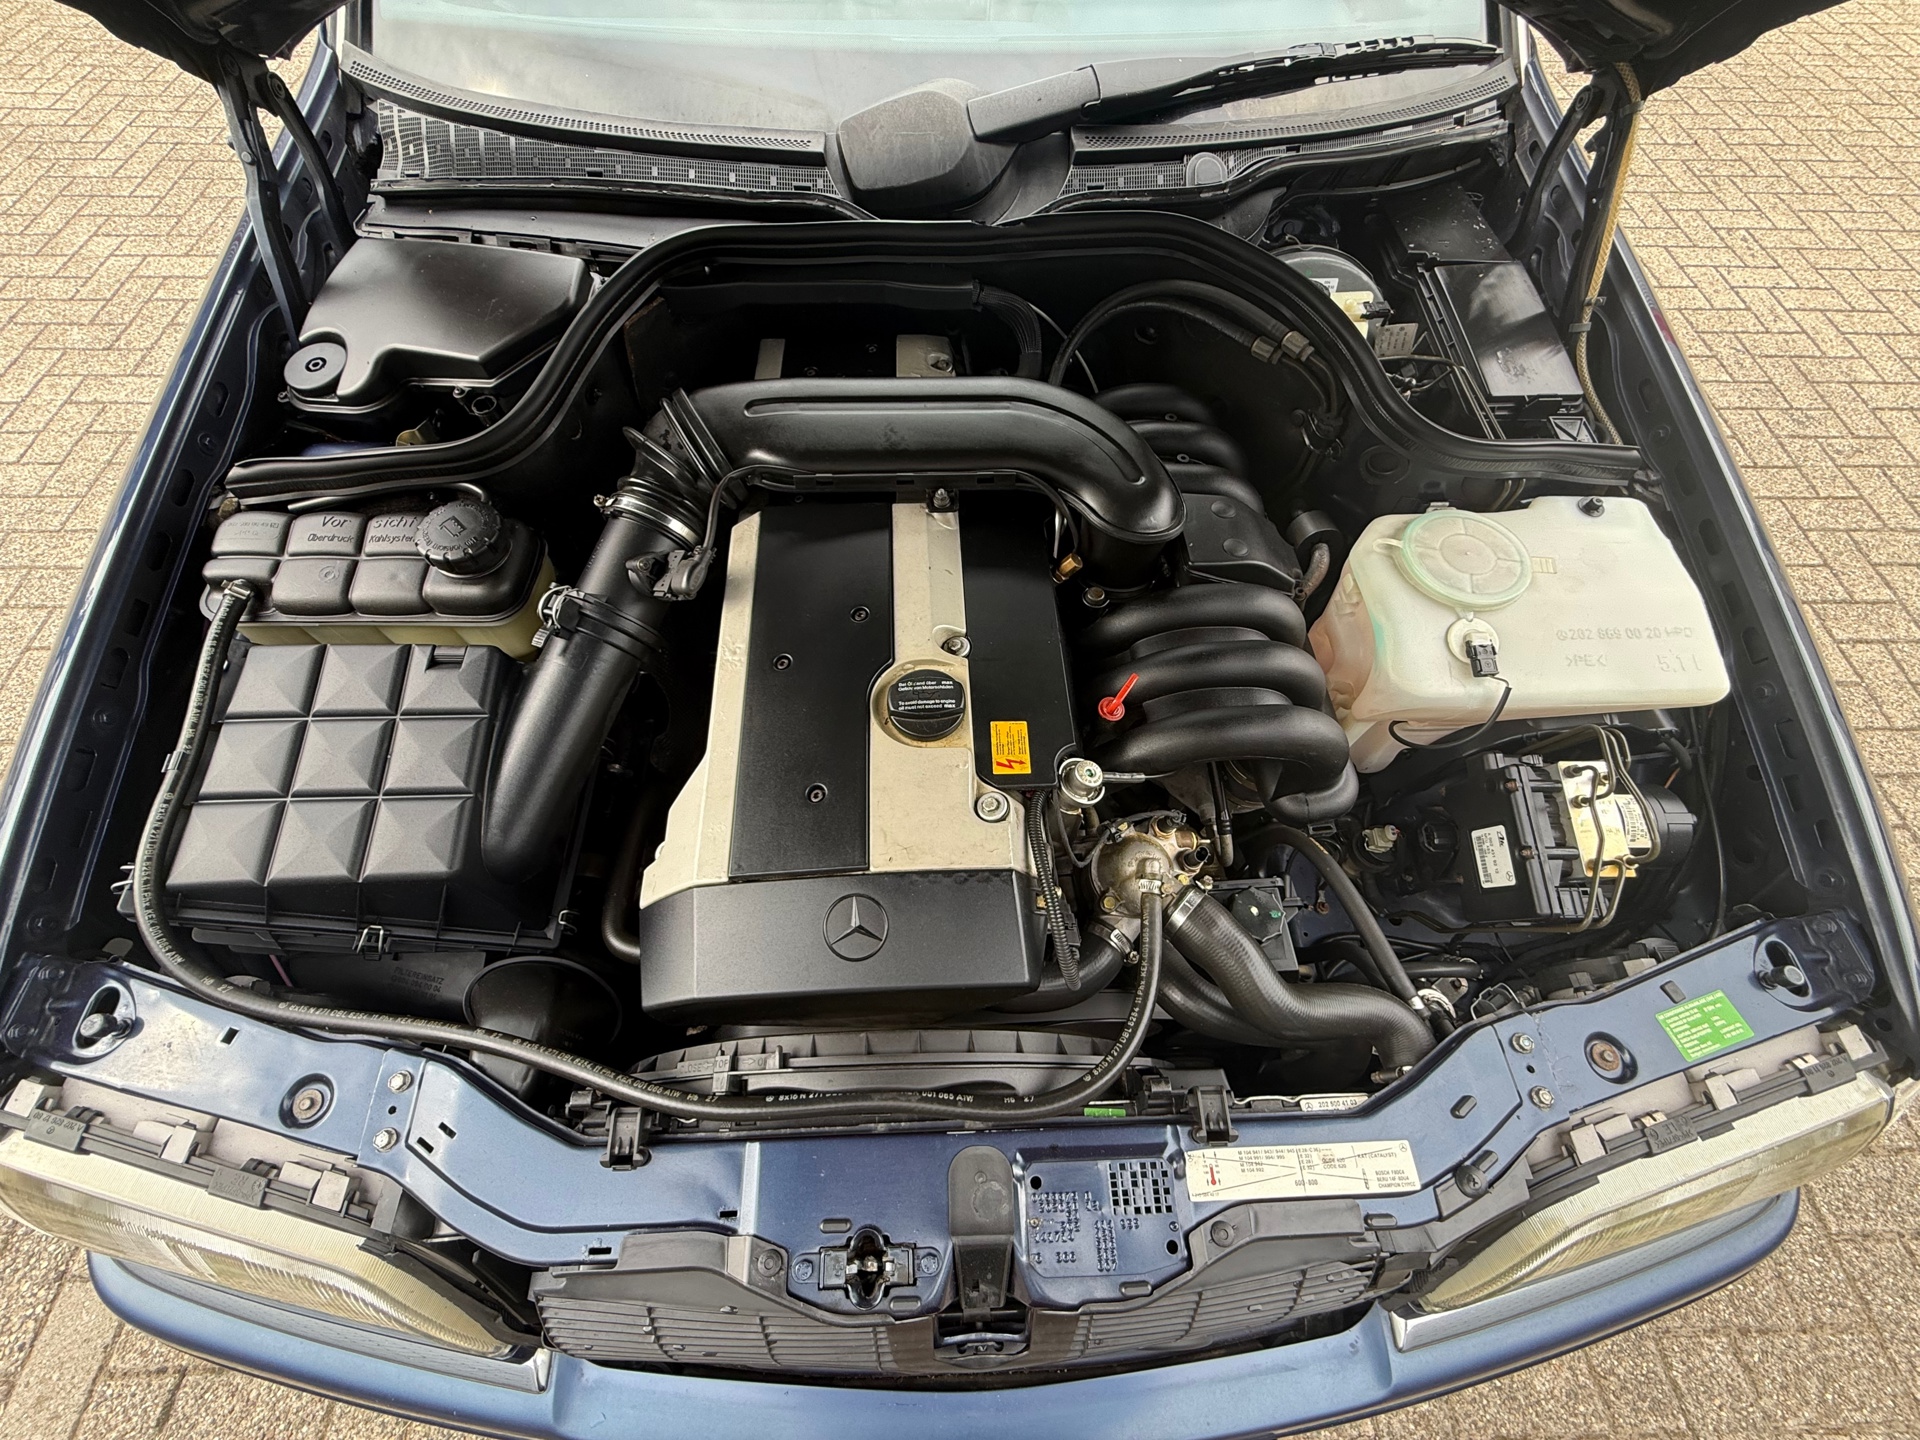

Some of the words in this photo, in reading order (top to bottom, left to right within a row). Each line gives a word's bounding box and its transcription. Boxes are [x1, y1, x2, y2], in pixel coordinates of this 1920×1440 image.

[322, 516, 352, 528] Vor
[1139, 959, 1148, 977] KEK
[1136, 980, 1145, 995] Phx
[1118, 1026, 1132, 1044] DBL
[1110, 1042, 1123, 1056] 271
[75, 1123, 83, 1134] A
